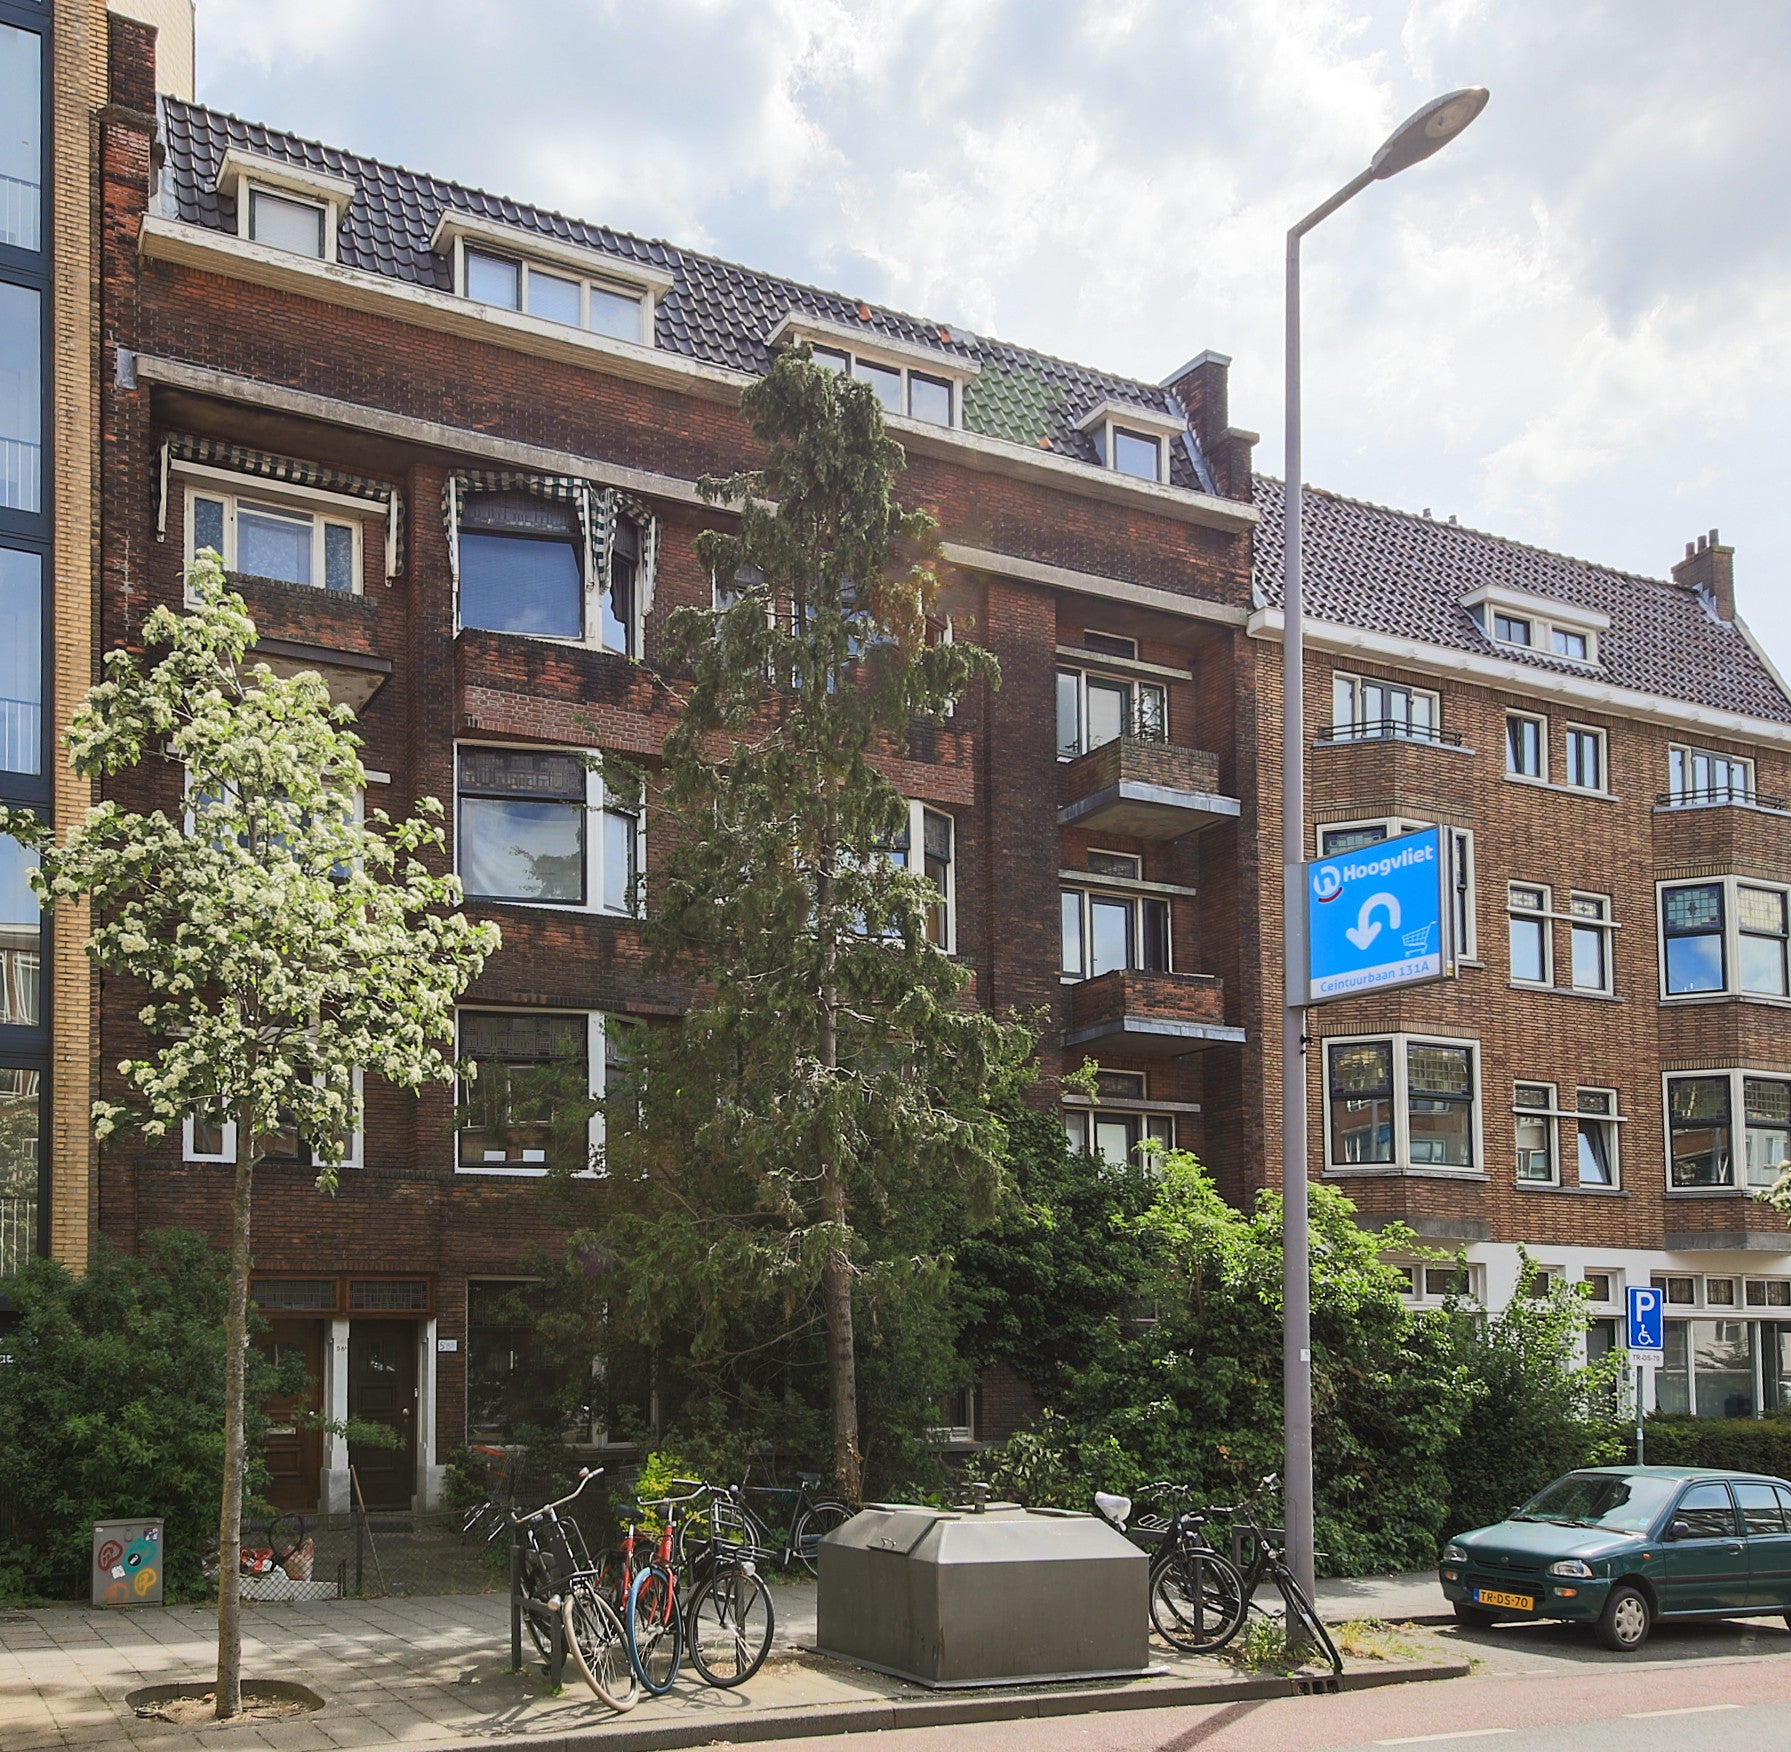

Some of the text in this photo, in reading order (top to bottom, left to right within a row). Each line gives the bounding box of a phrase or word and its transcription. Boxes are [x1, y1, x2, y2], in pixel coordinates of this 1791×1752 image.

[1343, 845, 1434, 883] Hoogvliet
[1320, 961, 1430, 993] Ceintuurbaan 131A
[1636, 1291, 1655, 1322] P
[1480, 1591, 1528, 1608] TR-DS-70
